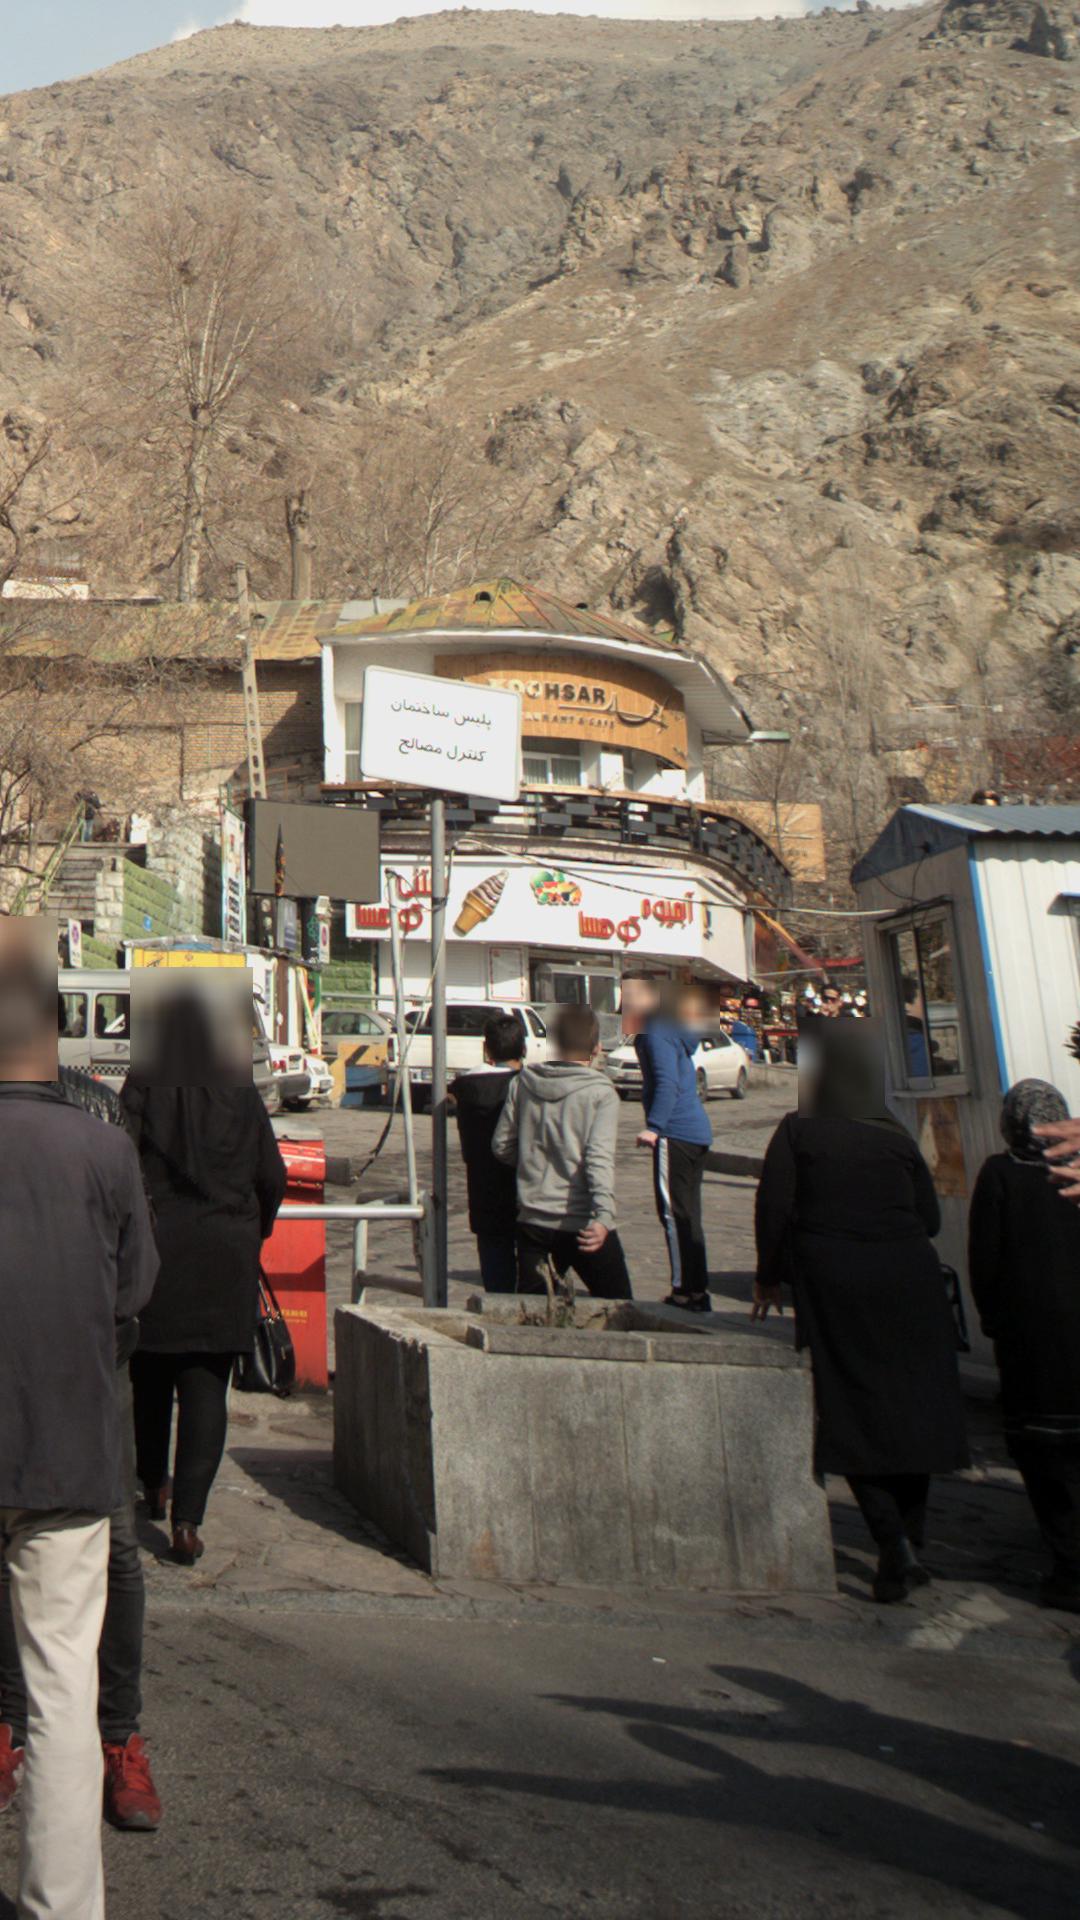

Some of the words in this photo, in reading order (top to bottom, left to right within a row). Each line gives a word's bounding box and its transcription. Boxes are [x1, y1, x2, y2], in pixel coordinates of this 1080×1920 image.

[390, 699, 450, 718] ساختمان
[398, 737, 442, 755] مصالح
[446, 745, 487, 762] کنترل
